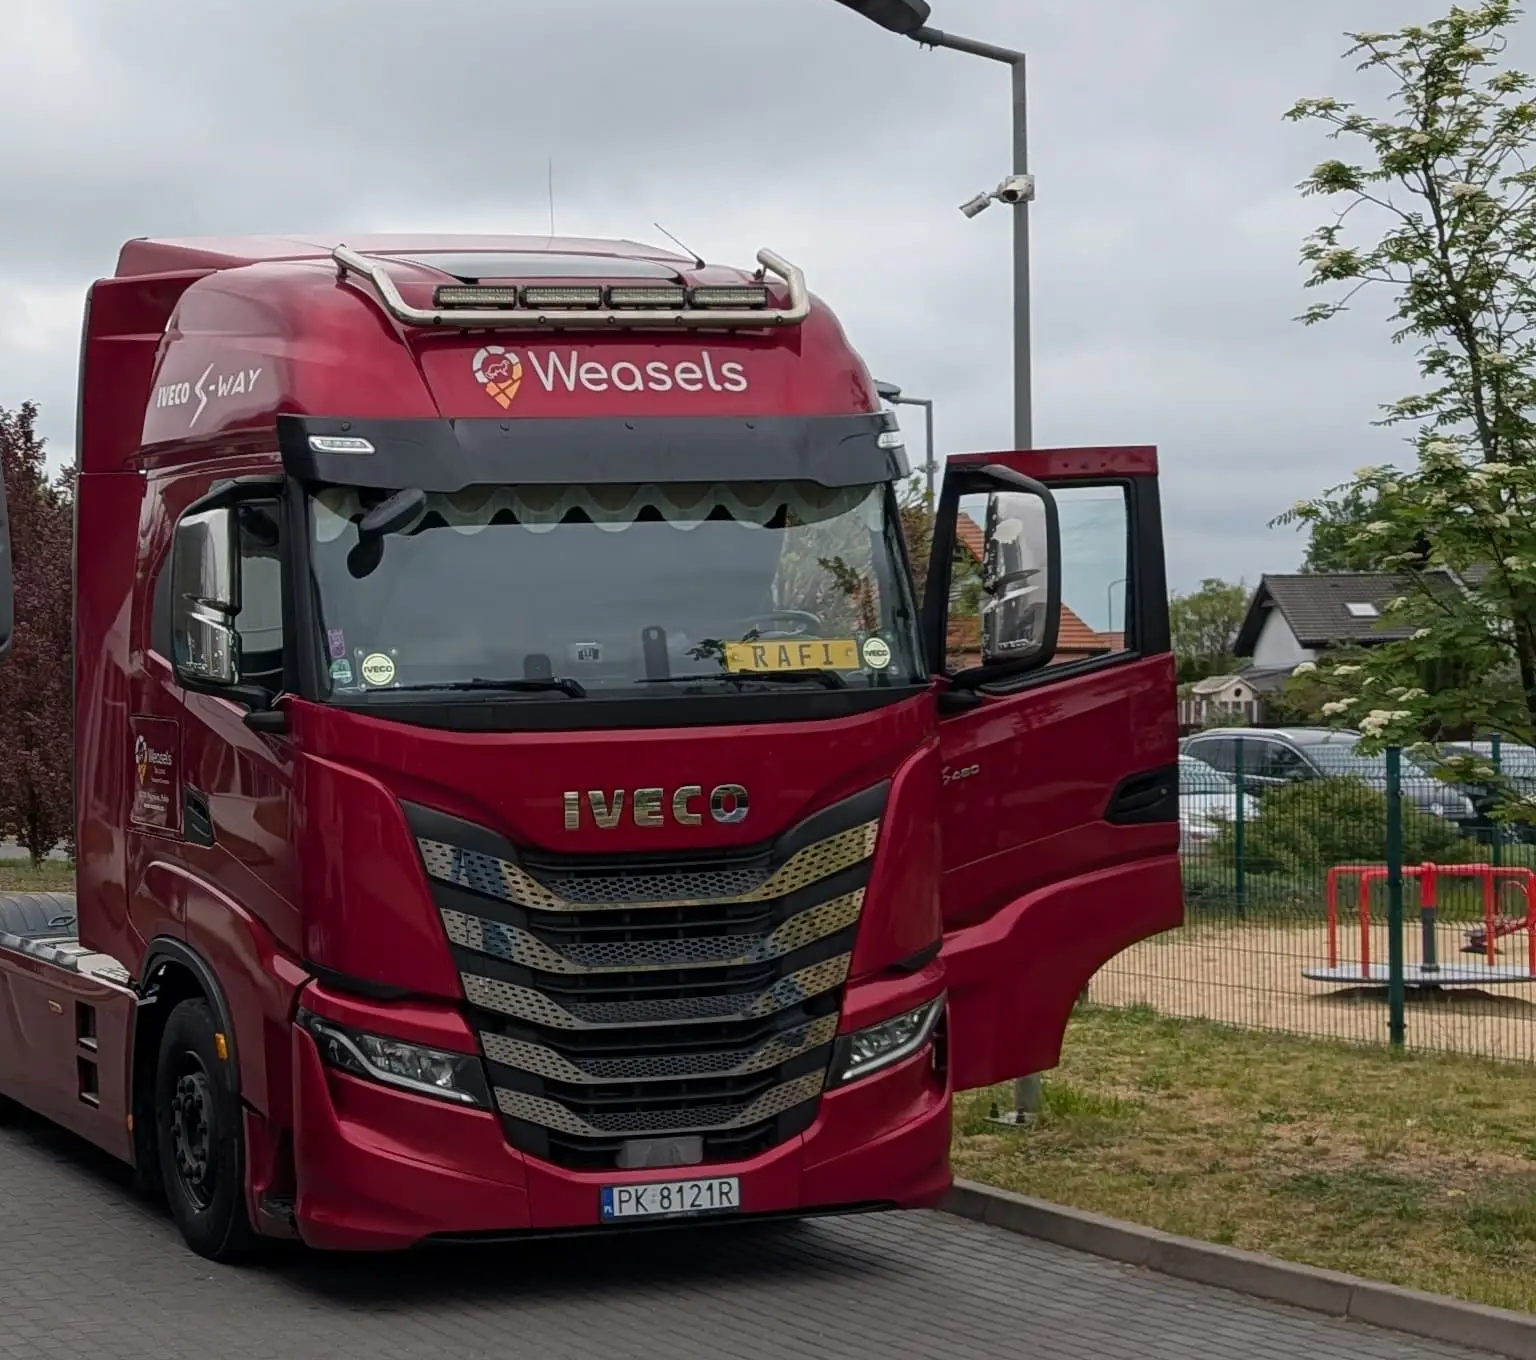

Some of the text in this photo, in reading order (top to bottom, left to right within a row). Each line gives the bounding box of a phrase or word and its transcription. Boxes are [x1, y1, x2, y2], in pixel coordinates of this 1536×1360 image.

[527, 350, 748, 392] Weasels
[156, 362, 263, 429] IVECO S-WAY
[363, 665, 393, 674] IVECO
[751, 643, 834, 669] RAFI
[864, 648, 889, 658] IVECO
[564, 783, 750, 830] IVECO
[618, 1181, 734, 1214] PK 8121R
